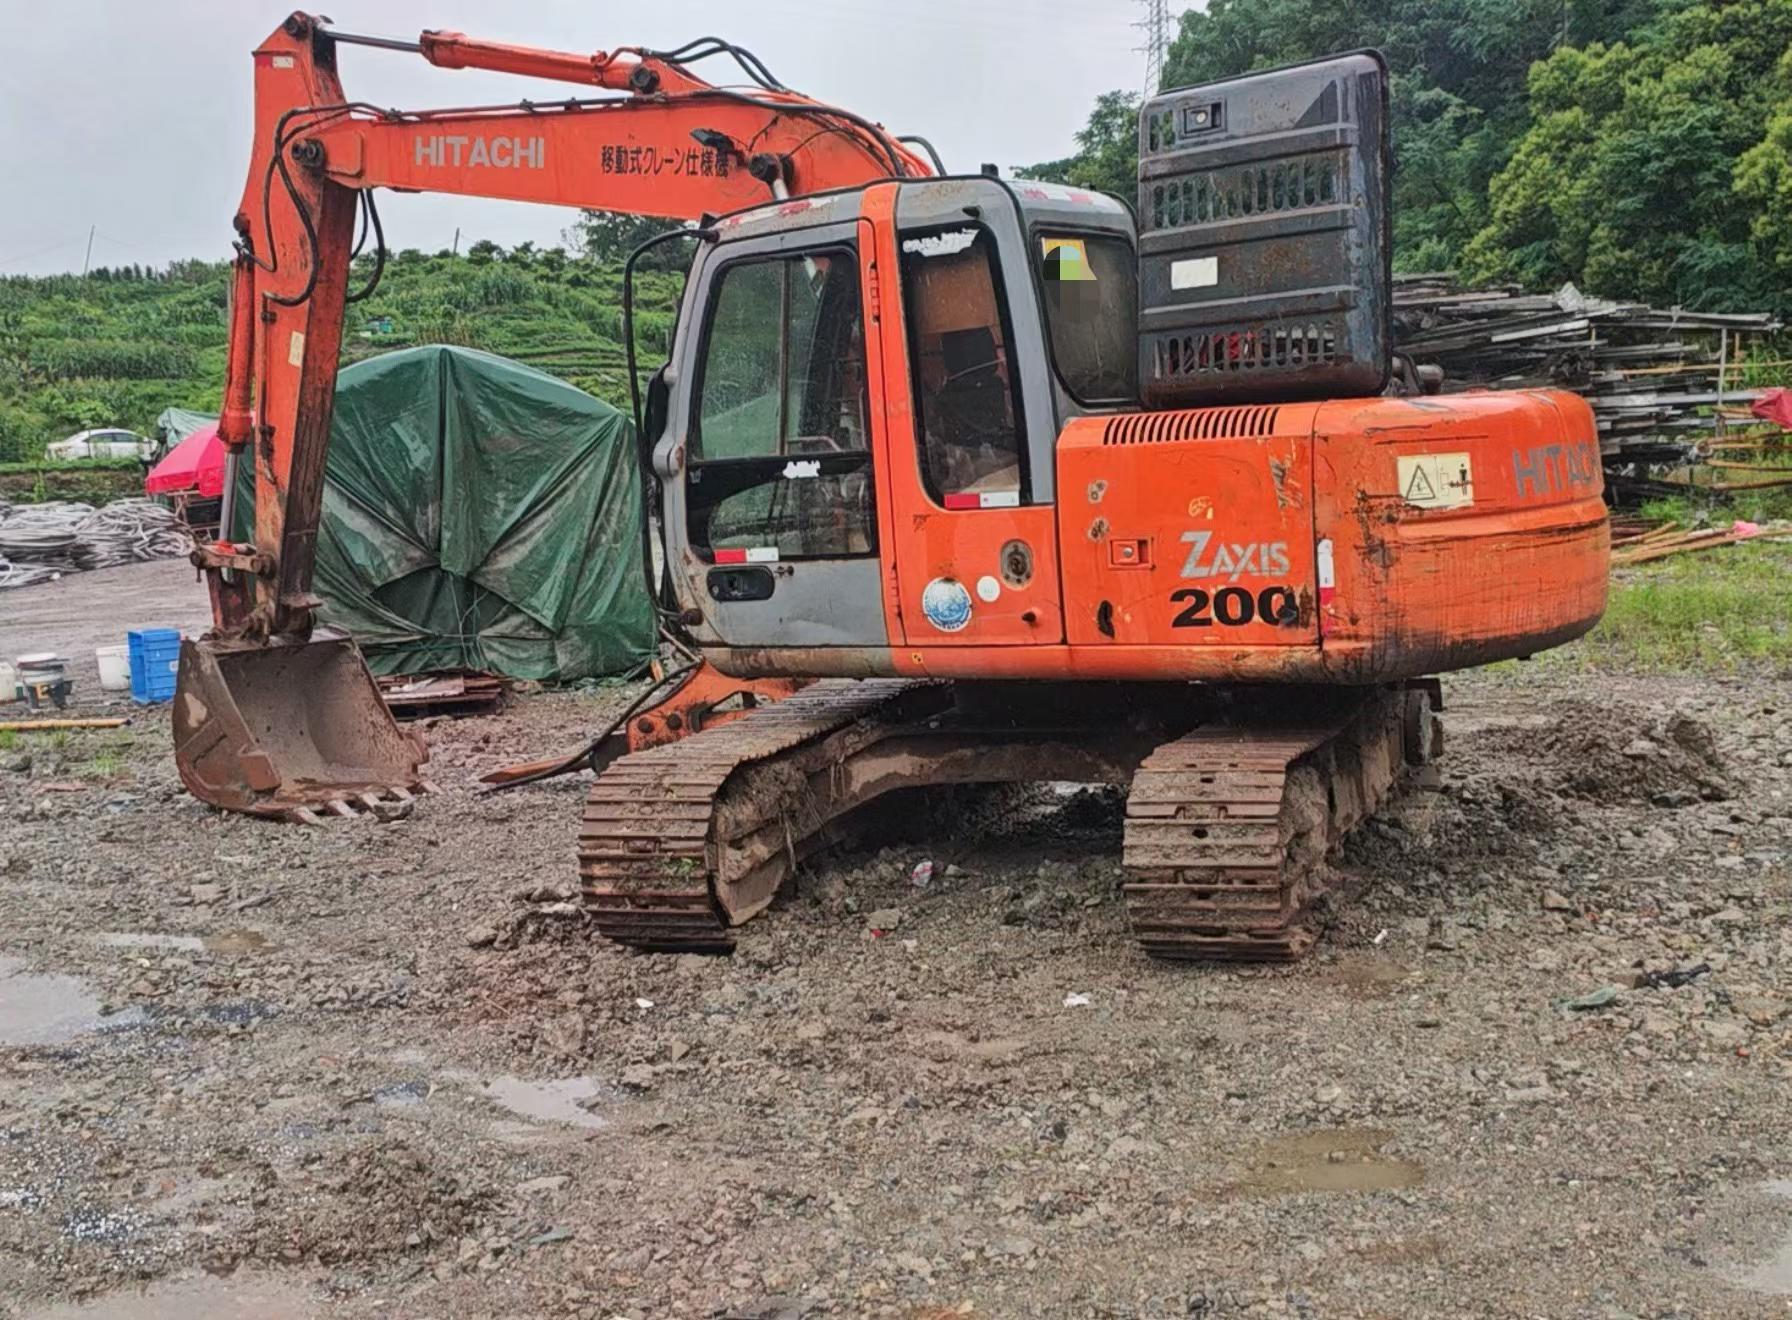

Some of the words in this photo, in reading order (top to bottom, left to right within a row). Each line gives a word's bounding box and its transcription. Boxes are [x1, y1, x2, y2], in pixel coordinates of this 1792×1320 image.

[415, 135, 545, 168] HITACHI
[1180, 531, 1290, 582] ZAXIS
[1170, 586, 1300, 628] 200
